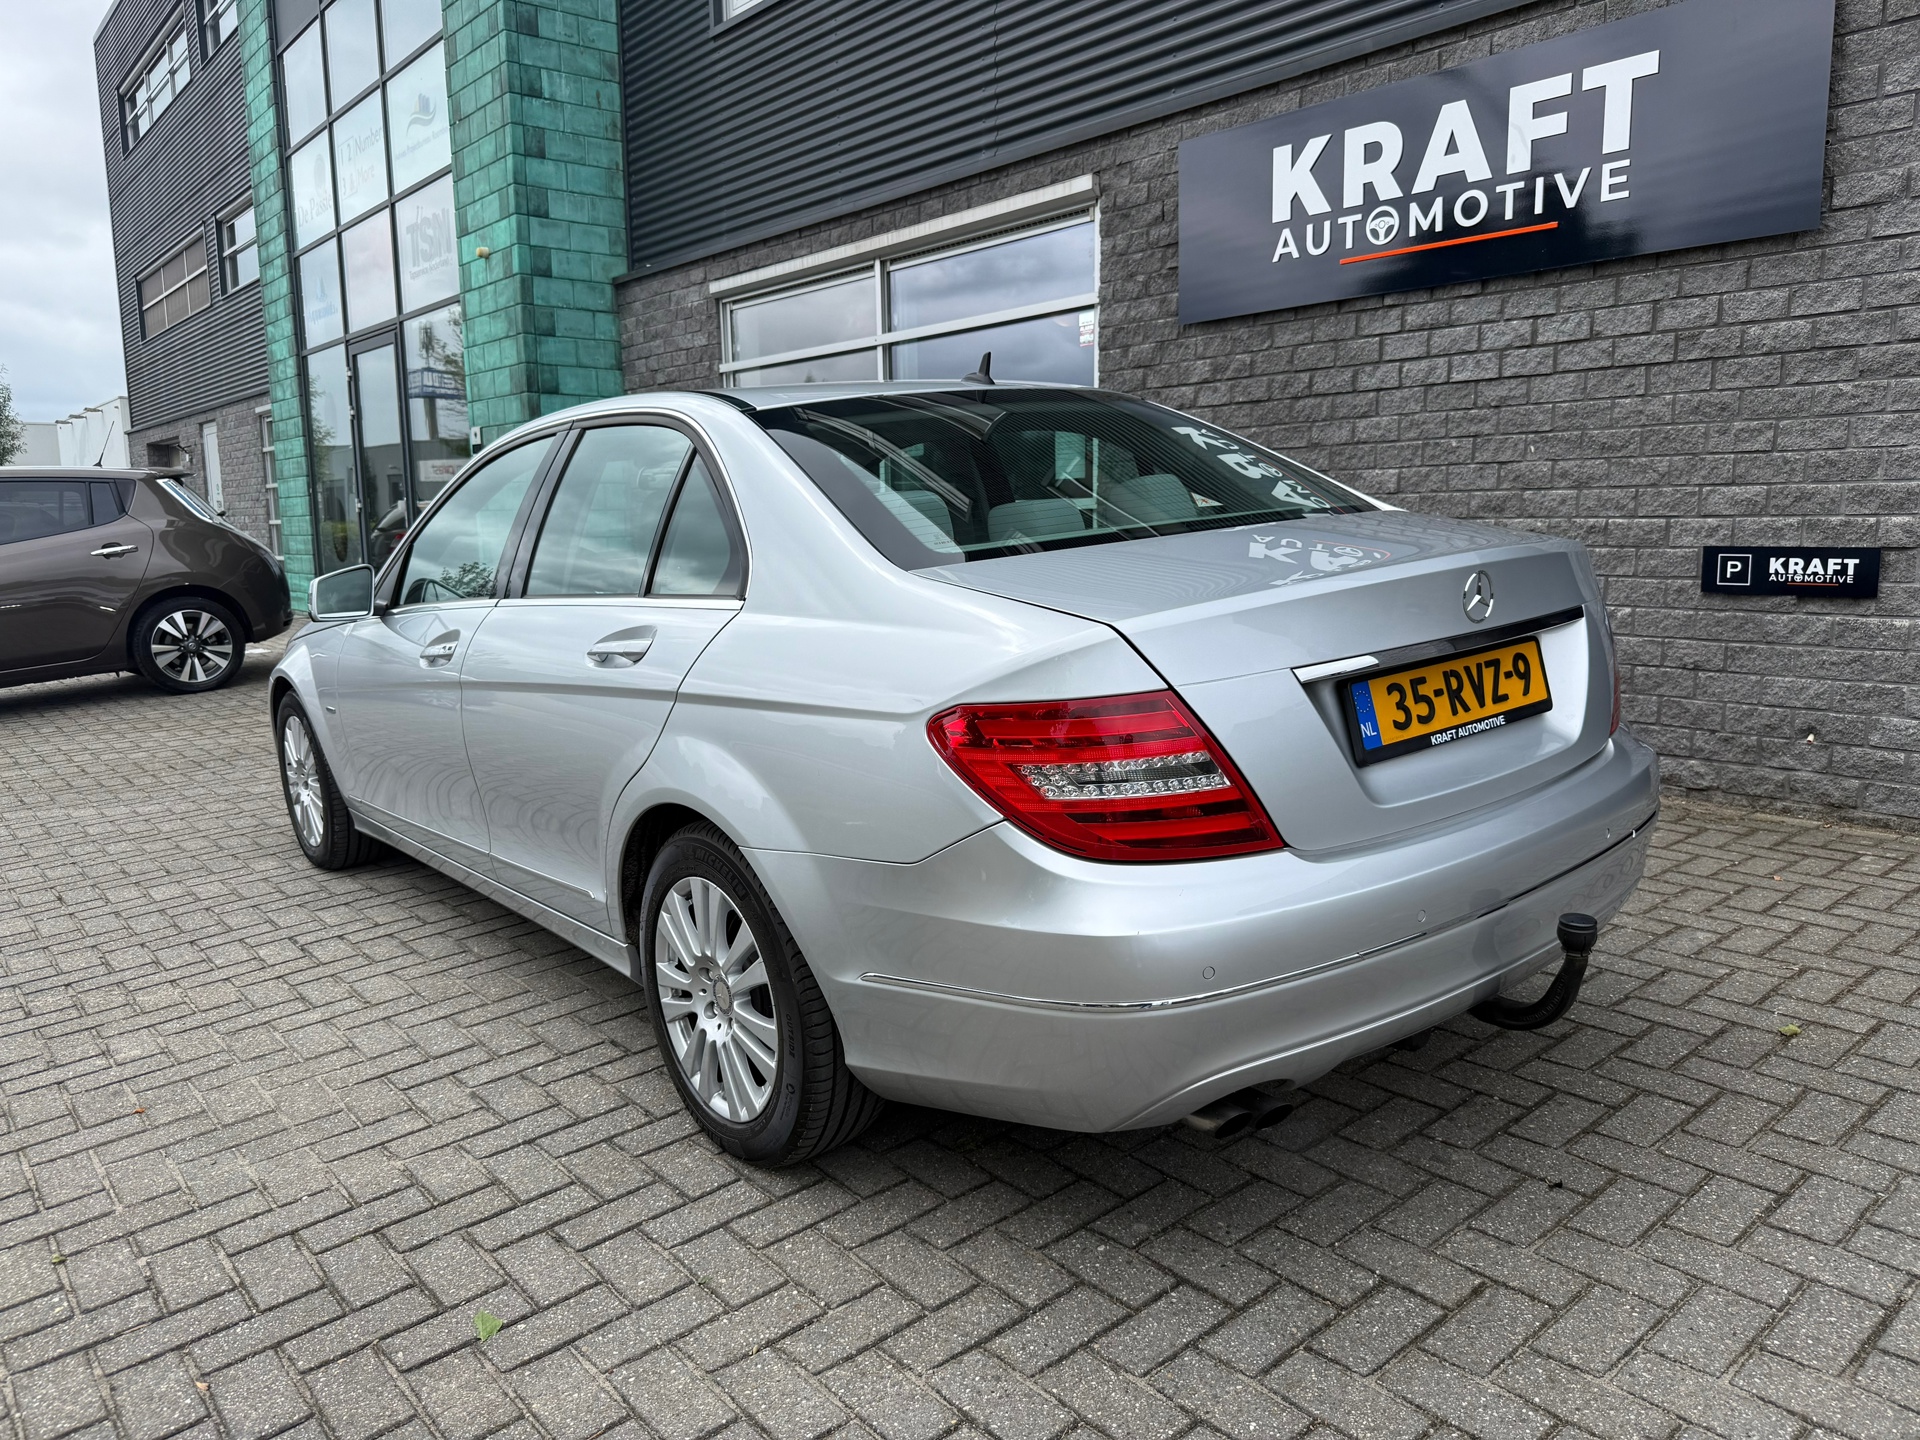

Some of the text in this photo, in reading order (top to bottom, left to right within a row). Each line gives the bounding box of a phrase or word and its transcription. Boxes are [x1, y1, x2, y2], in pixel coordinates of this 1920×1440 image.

[1272, 50, 1660, 224] KRAFT
[1271, 159, 1631, 263] AUTOMOTIVE
[1768, 557, 1860, 575] KRAFT
[1768, 574, 1854, 583] AUTOMOTIVE
[1360, 652, 1531, 737] NL 35-RVZ-9
[1430, 715, 1506, 745] KRAFT AUTOMOTIVE
[695, 848, 748, 898] MICHELIN
[785, 1012, 796, 1059] OUTSIDE
